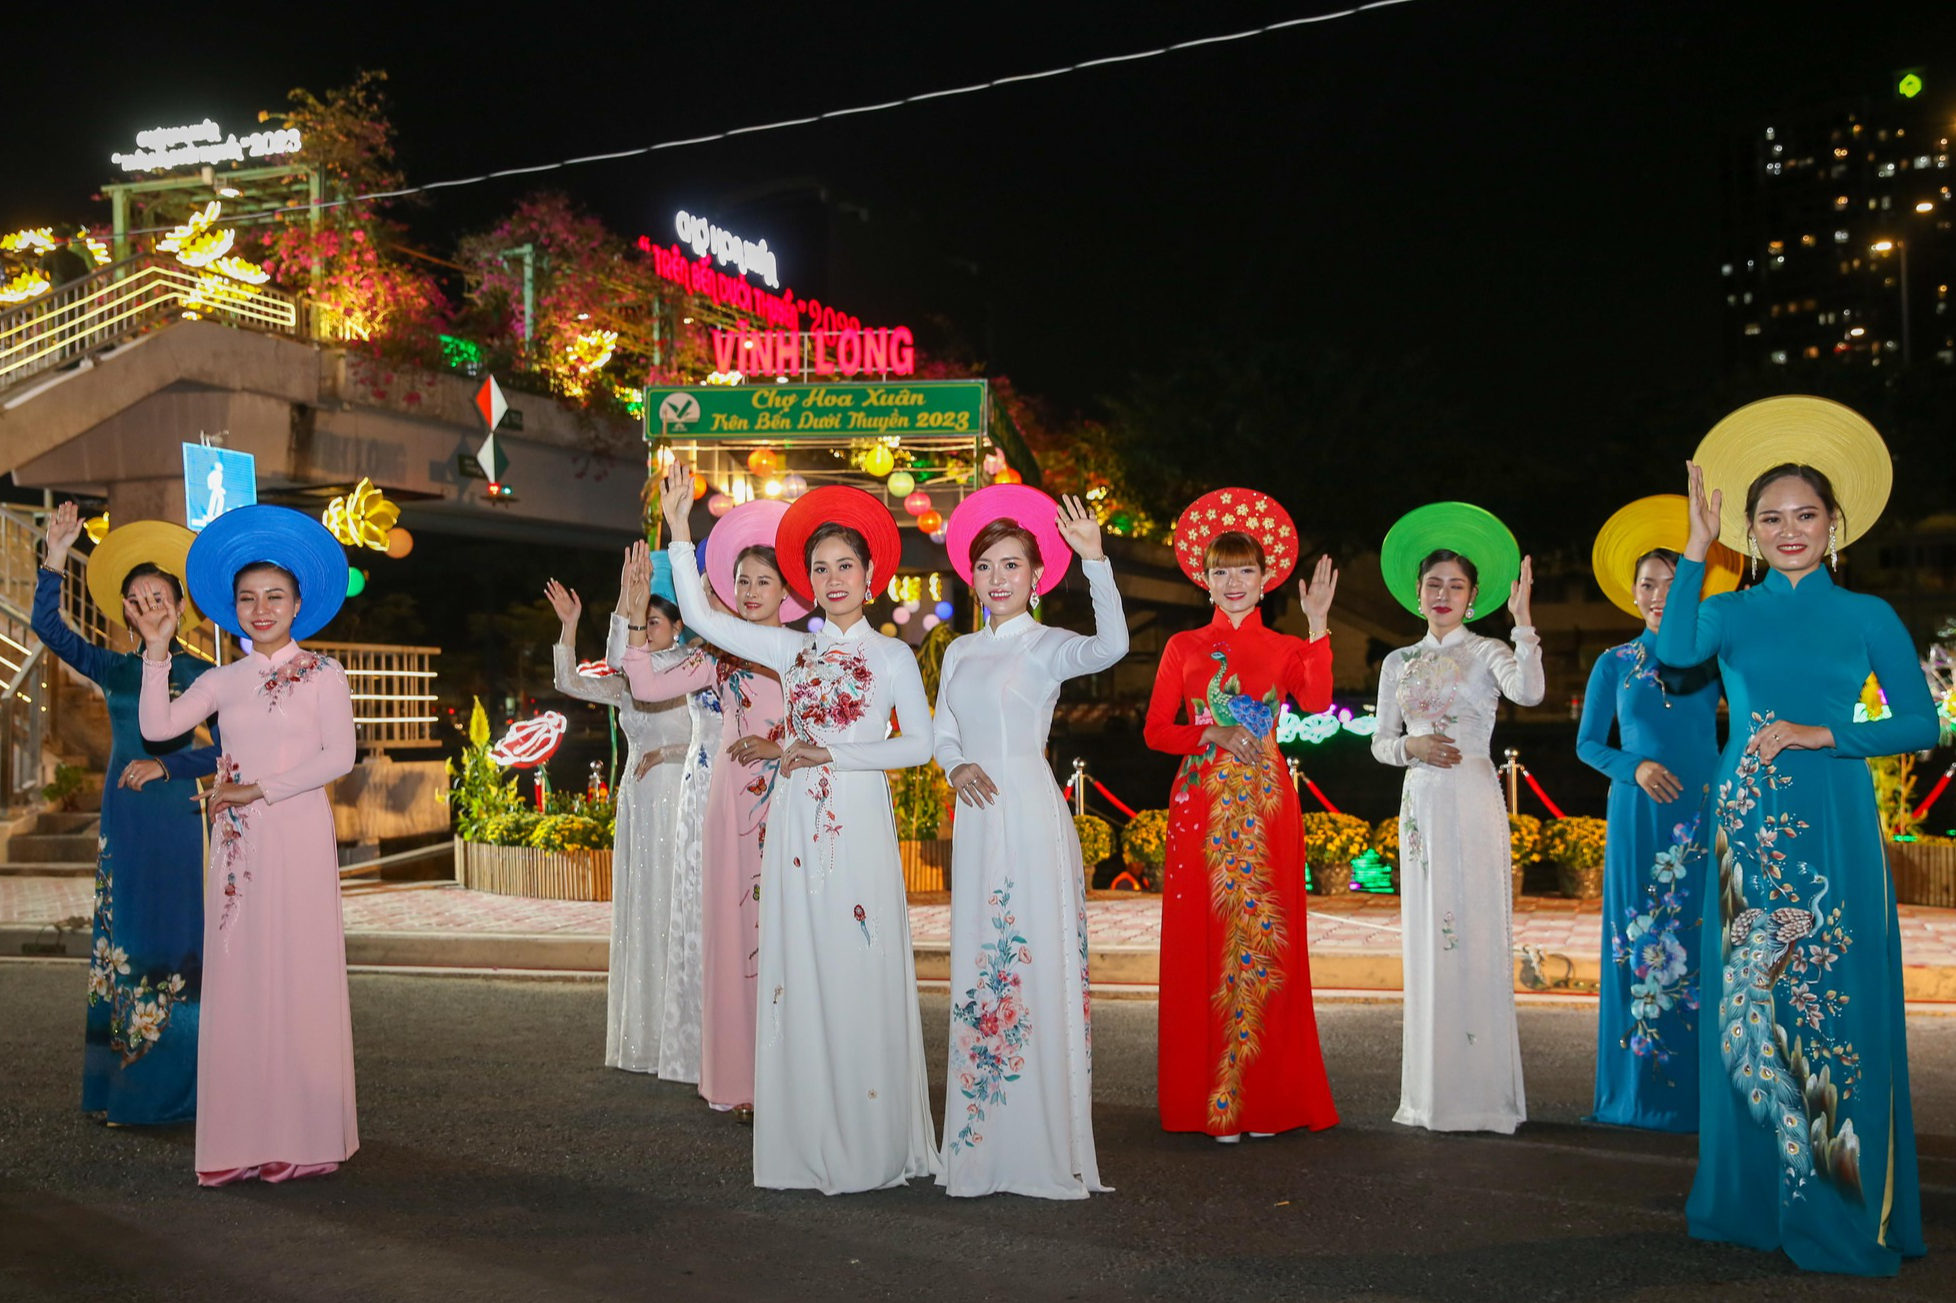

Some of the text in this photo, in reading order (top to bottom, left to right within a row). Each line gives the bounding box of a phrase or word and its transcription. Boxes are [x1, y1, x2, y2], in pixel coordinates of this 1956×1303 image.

[815, 326, 914, 375] LONG
[752, 388, 925, 412] Chợ Hoa Xuân
[710, 408, 970, 433] Trên Bến Dưới Thuyền 2023
